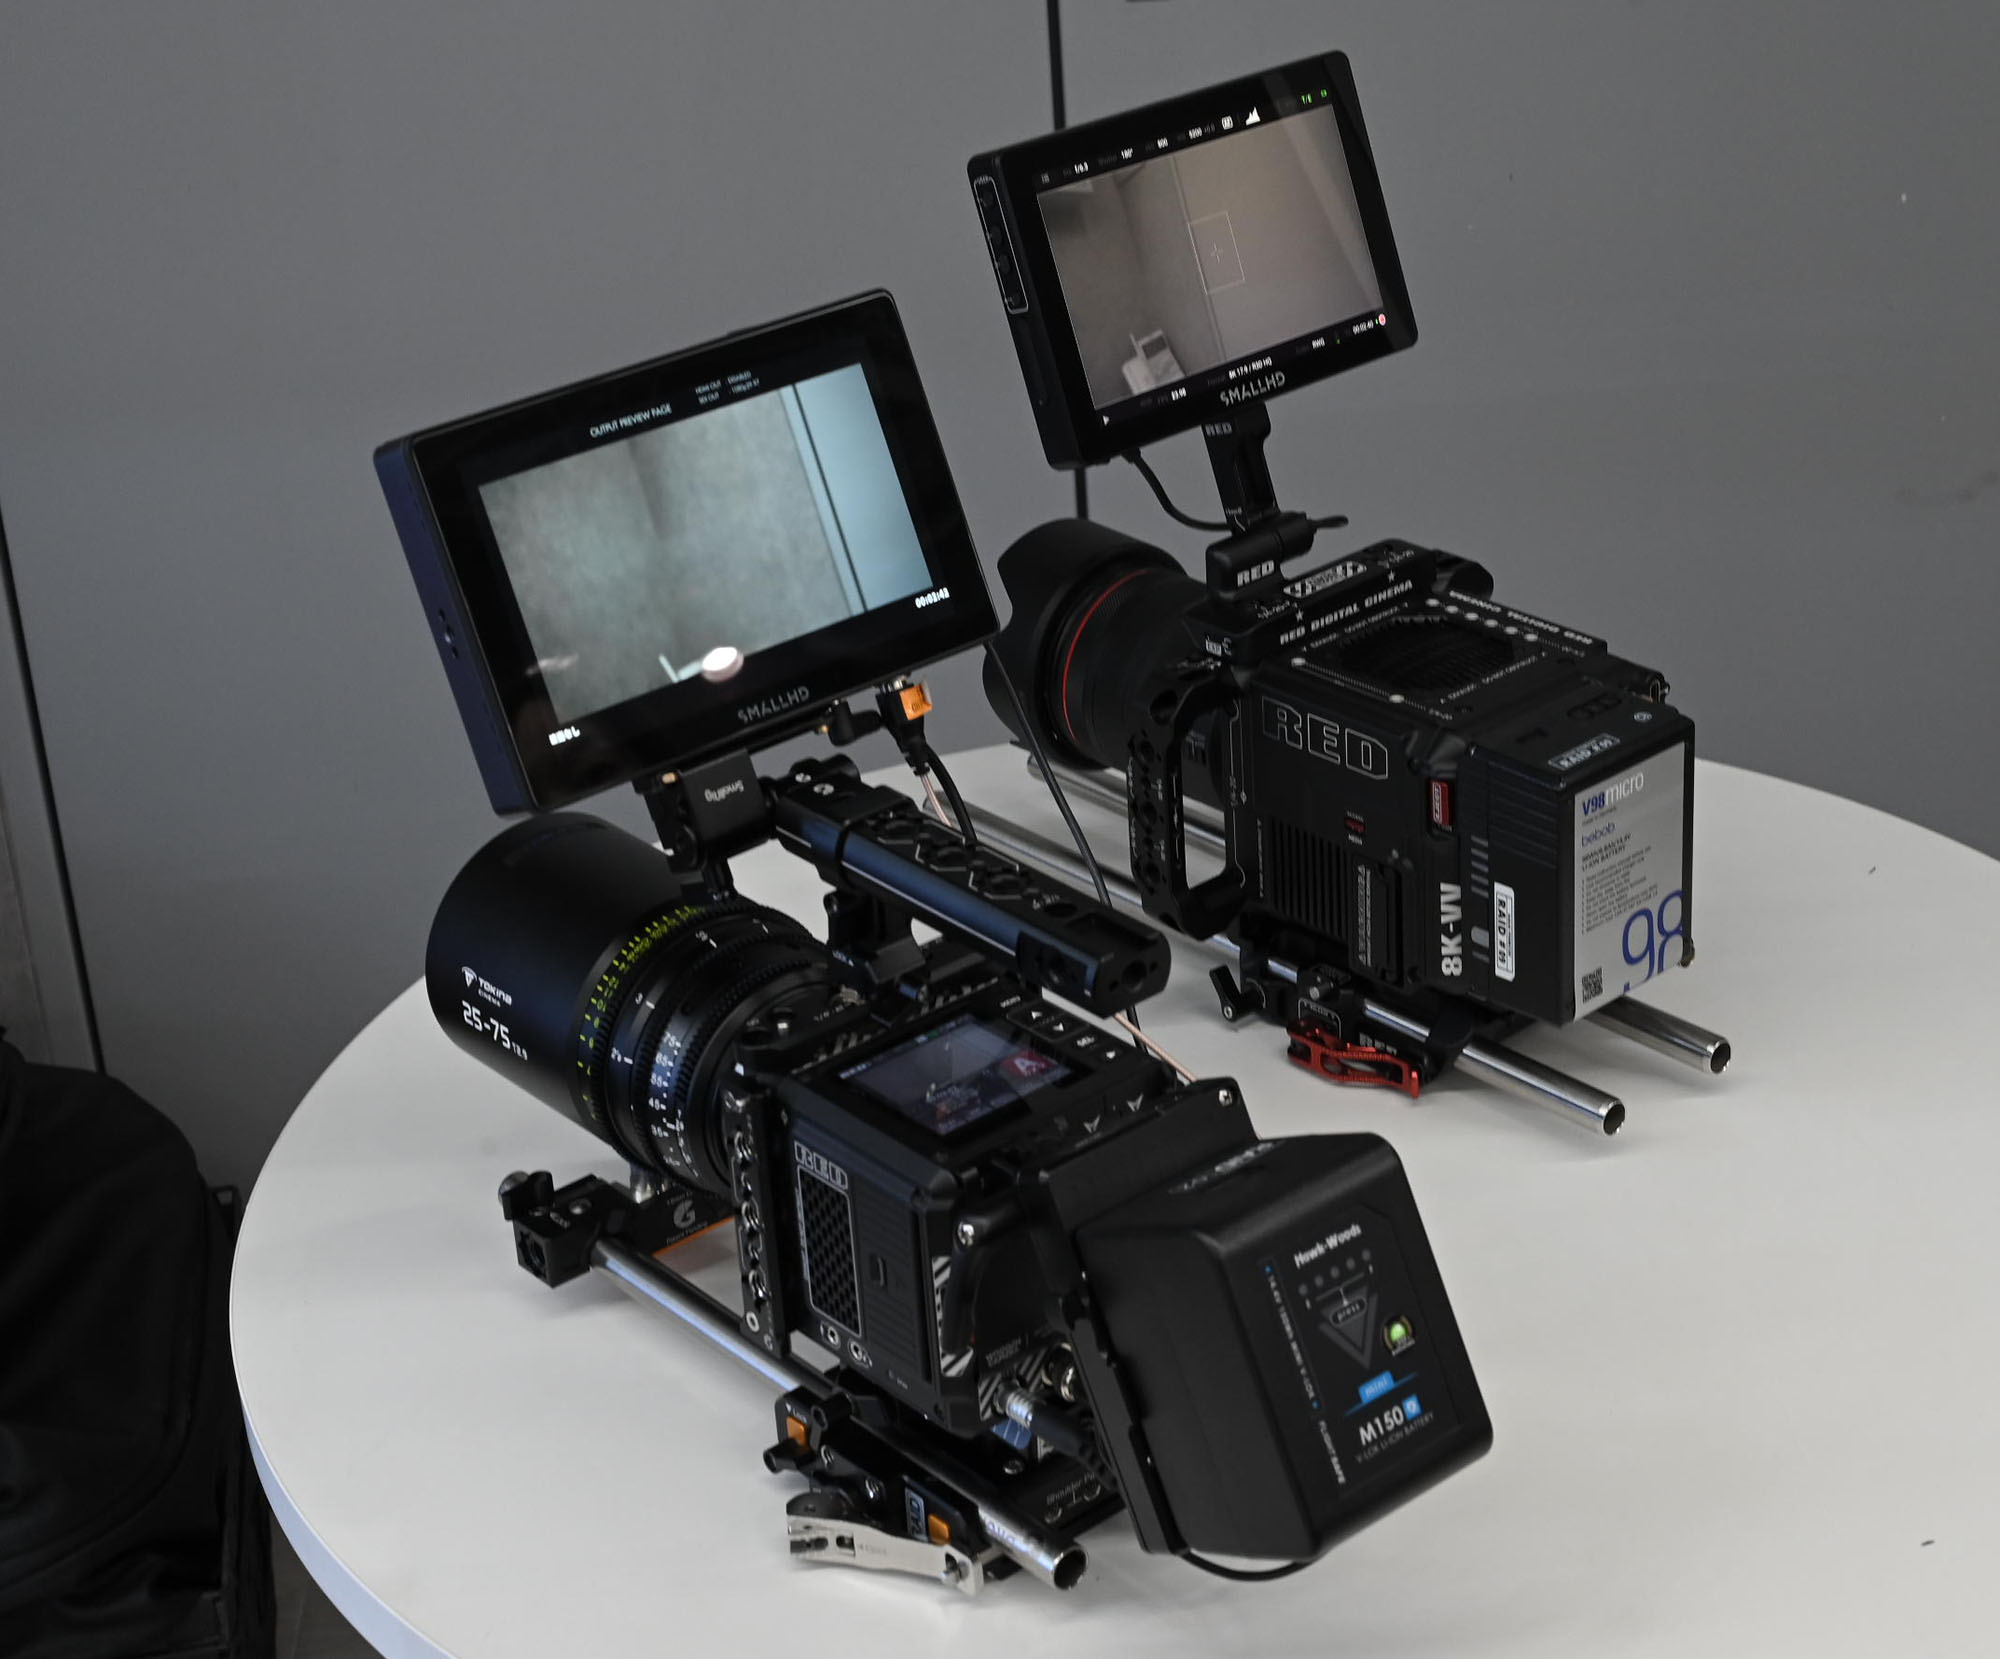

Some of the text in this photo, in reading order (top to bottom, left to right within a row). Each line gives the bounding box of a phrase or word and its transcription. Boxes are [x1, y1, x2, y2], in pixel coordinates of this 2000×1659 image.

[1219, 371, 1286, 407] SMALLHD
[590, 403, 672, 438] OUTPUT PREVIEW PAGE
[1205, 422, 1232, 437] RED
[1237, 560, 1275, 588] RED
[1280, 626, 1306, 645] RED
[1310, 602, 1360, 632] DIGITAL
[1364, 580, 1413, 608] CINEMA
[737, 686, 810, 724] SMALLHD
[1262, 695, 1389, 781] RED
[462, 1000, 511, 1049] 25-75
[794, 1140, 848, 1190] RED
[1294, 1224, 1362, 1269] Hawk-Woods
[1359, 1405, 1404, 1447] M150
